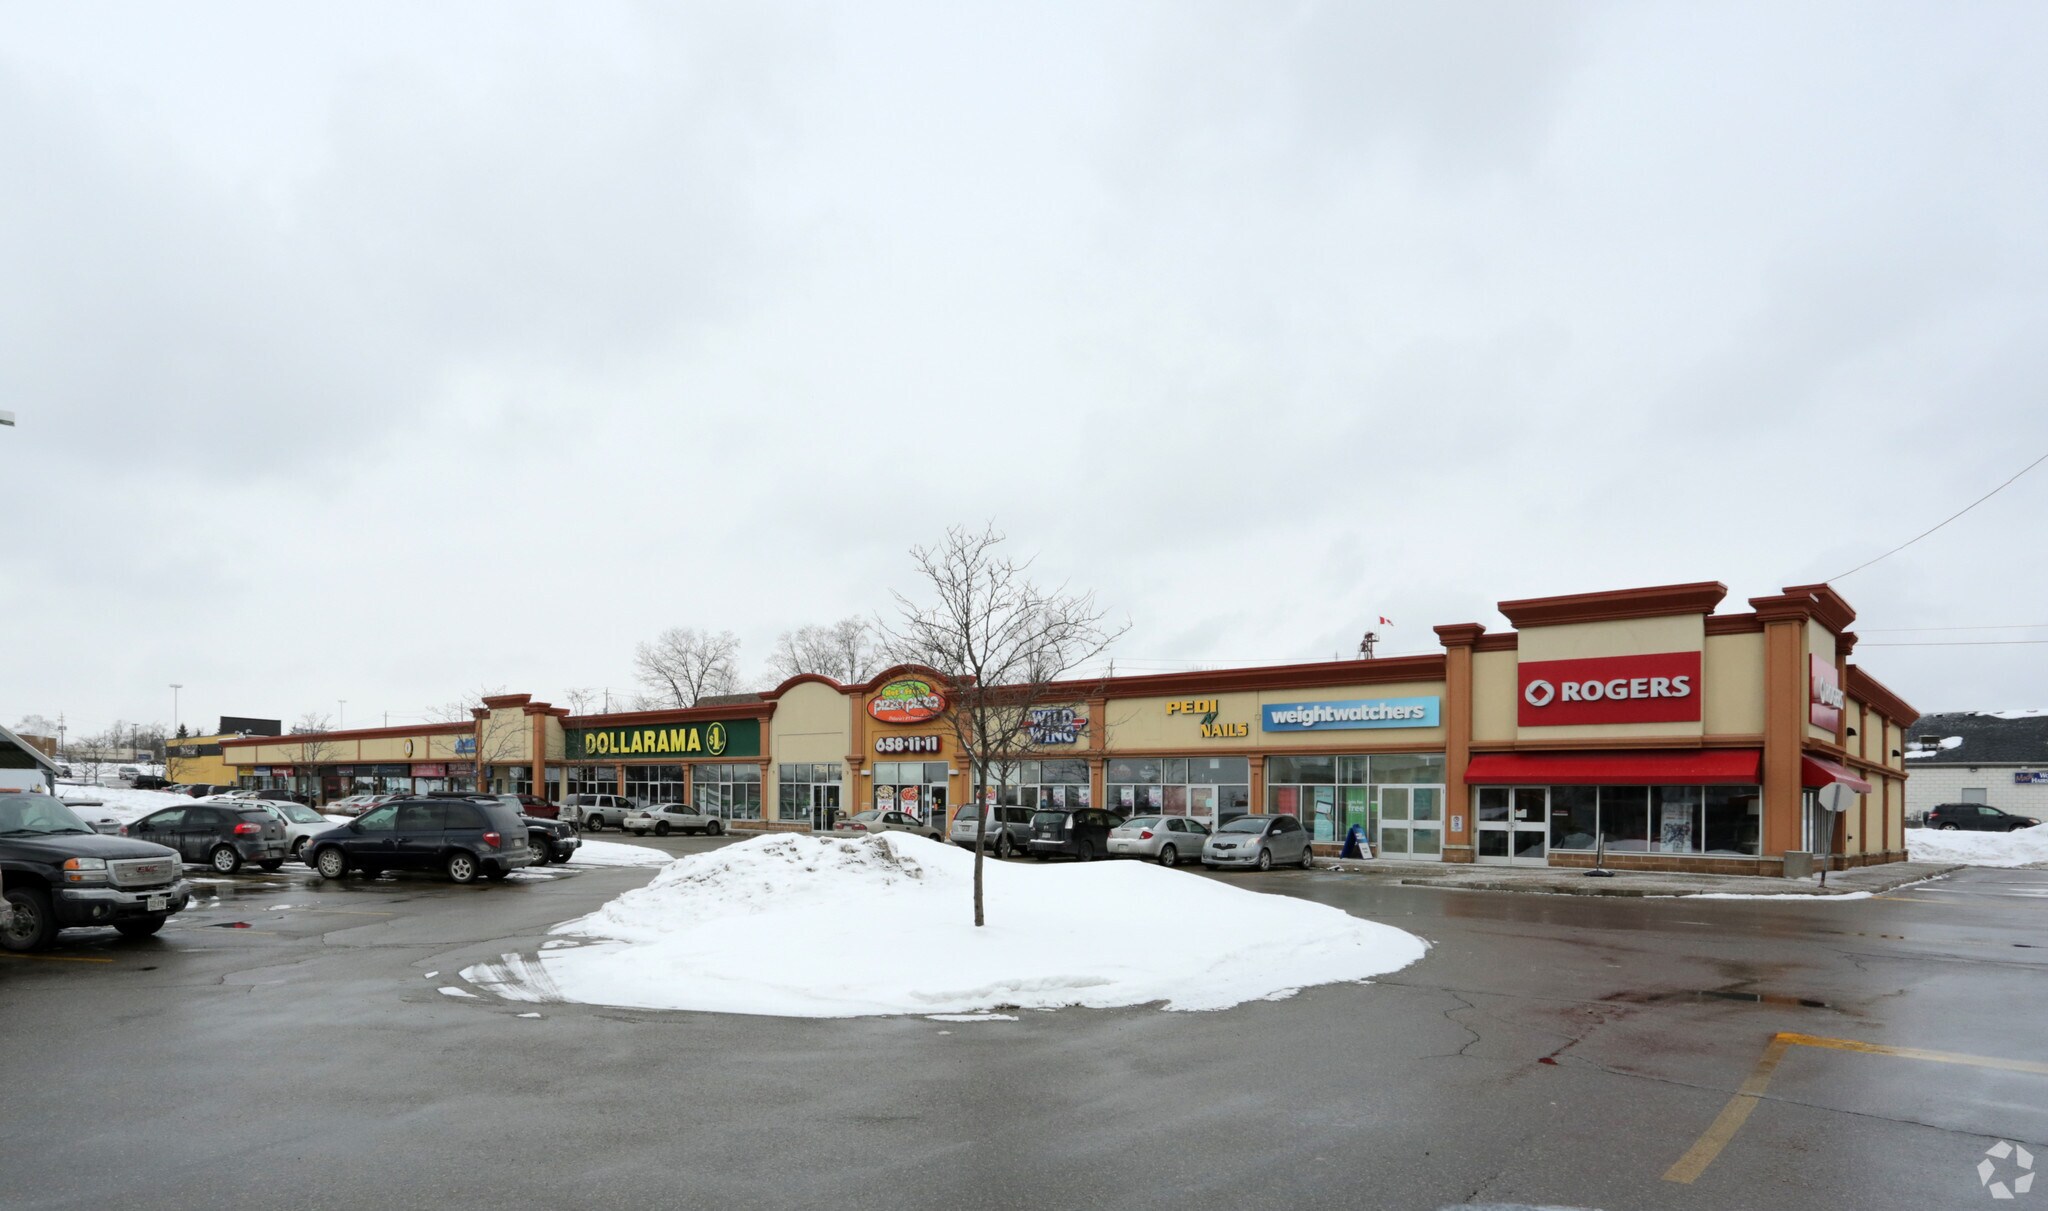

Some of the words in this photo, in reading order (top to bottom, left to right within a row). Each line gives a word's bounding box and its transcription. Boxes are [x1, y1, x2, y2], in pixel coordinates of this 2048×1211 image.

[1561, 675, 1691, 702] ROGERS
[1166, 699, 1217, 715] PEDI
[1271, 703, 1425, 727] weightwatchers
[1031, 709, 1075, 726] WILD
[1029, 726, 1075, 743] WING
[1200, 722, 1248, 738] NAILS
[585, 728, 701, 754] DOLLARAMA
